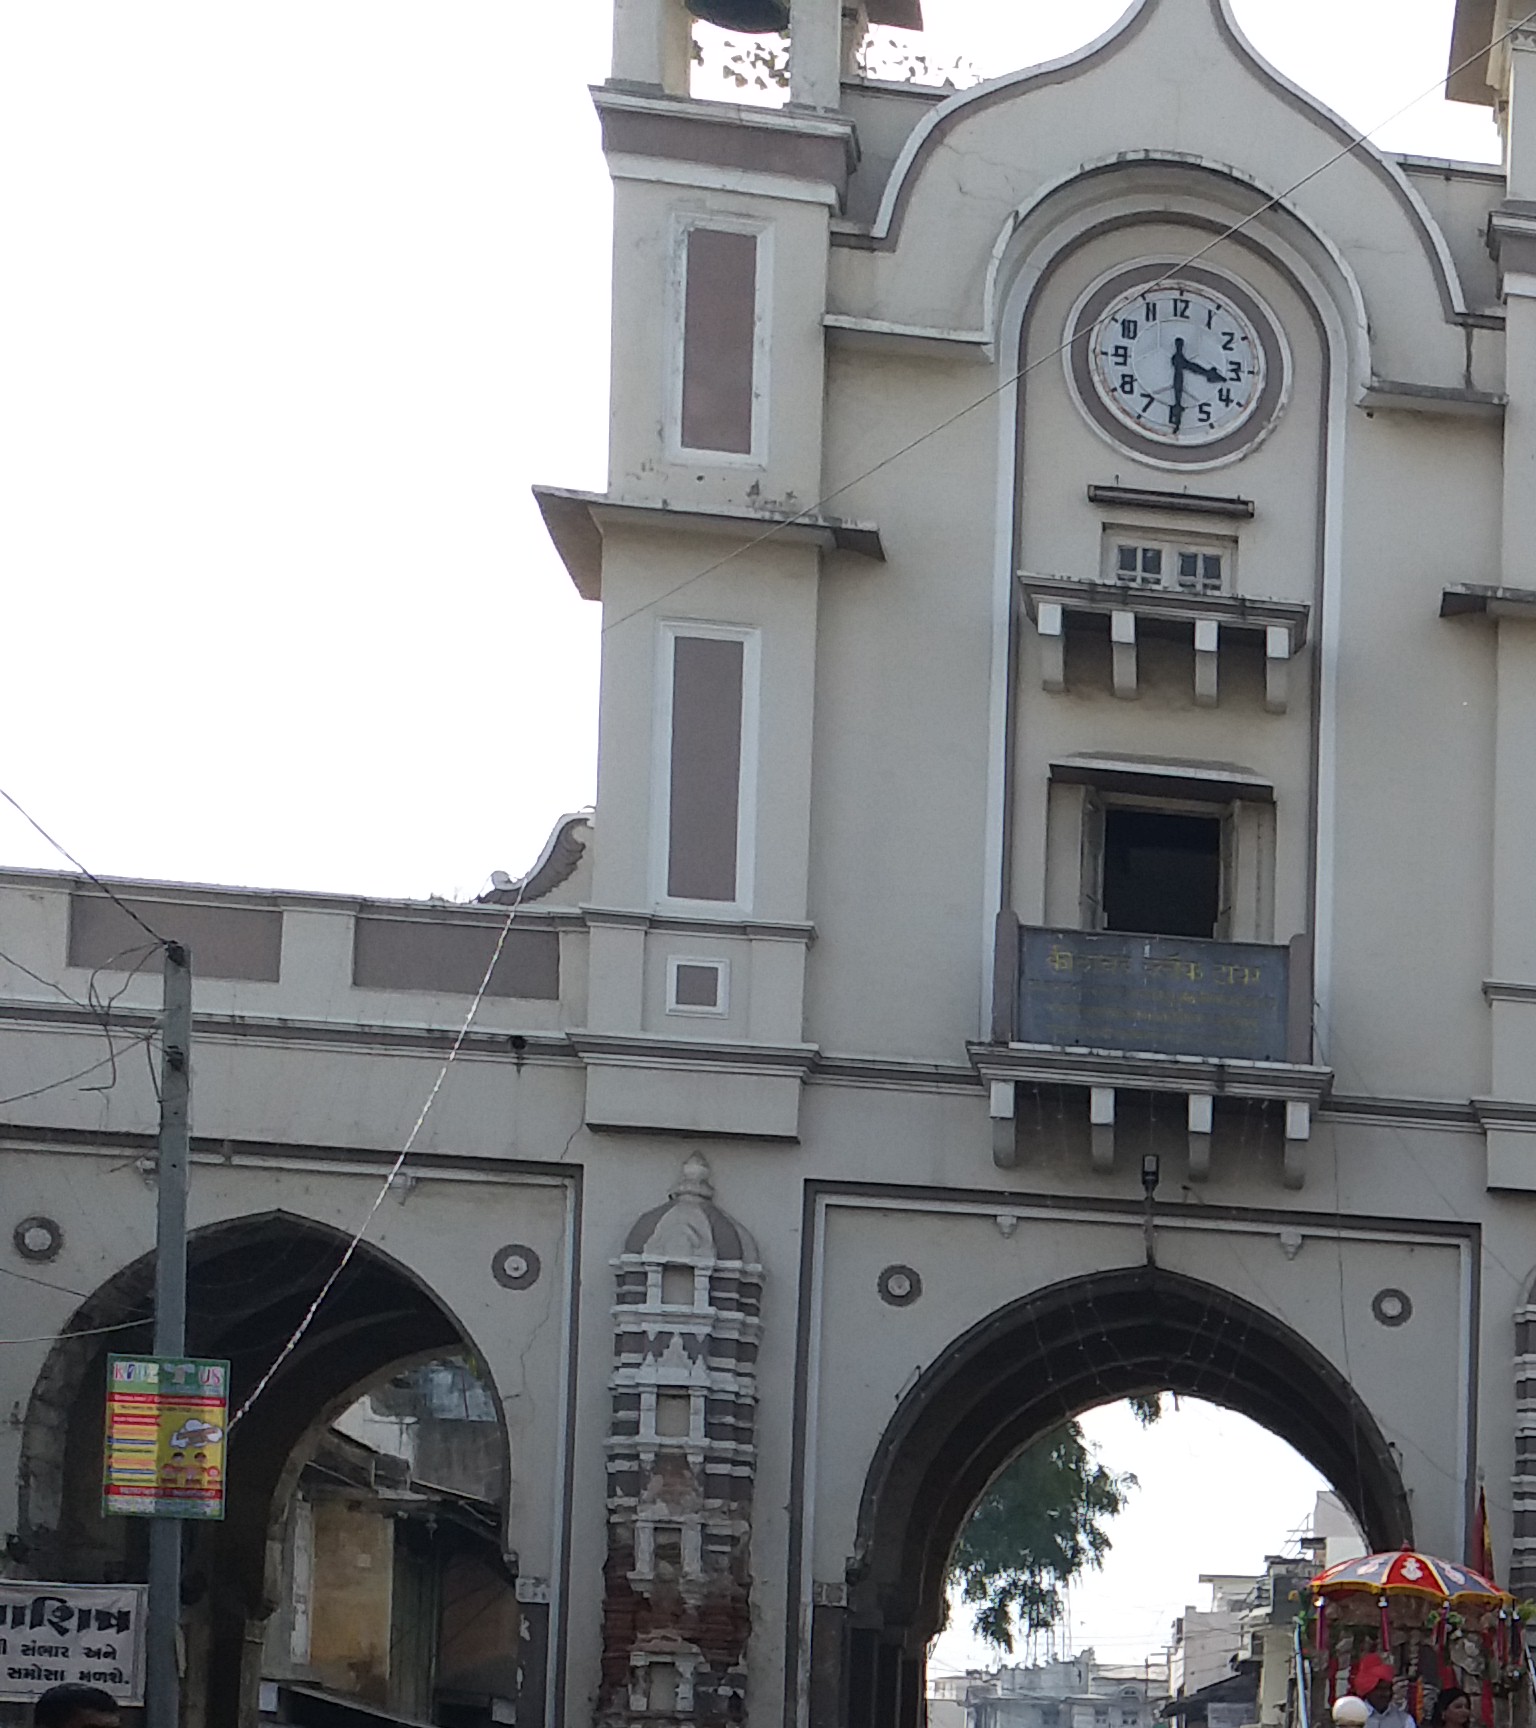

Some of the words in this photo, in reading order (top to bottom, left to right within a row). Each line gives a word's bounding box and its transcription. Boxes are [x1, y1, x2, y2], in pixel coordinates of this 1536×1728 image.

[1145, 302, 1157, 322] 11
[1173, 298, 1190, 319] 12
[1121, 318, 1138, 340] 10
[1206, 309, 1214, 330] 1
[1221, 332, 1235, 351] 2
[1114, 345, 1128, 366] 9
[1228, 360, 1242, 382] 3
[1120, 373, 1134, 395] 8
[1140, 392, 1155, 413] 7
[1218, 387, 1234, 408] 4
[1198, 403, 1211, 422] 5
